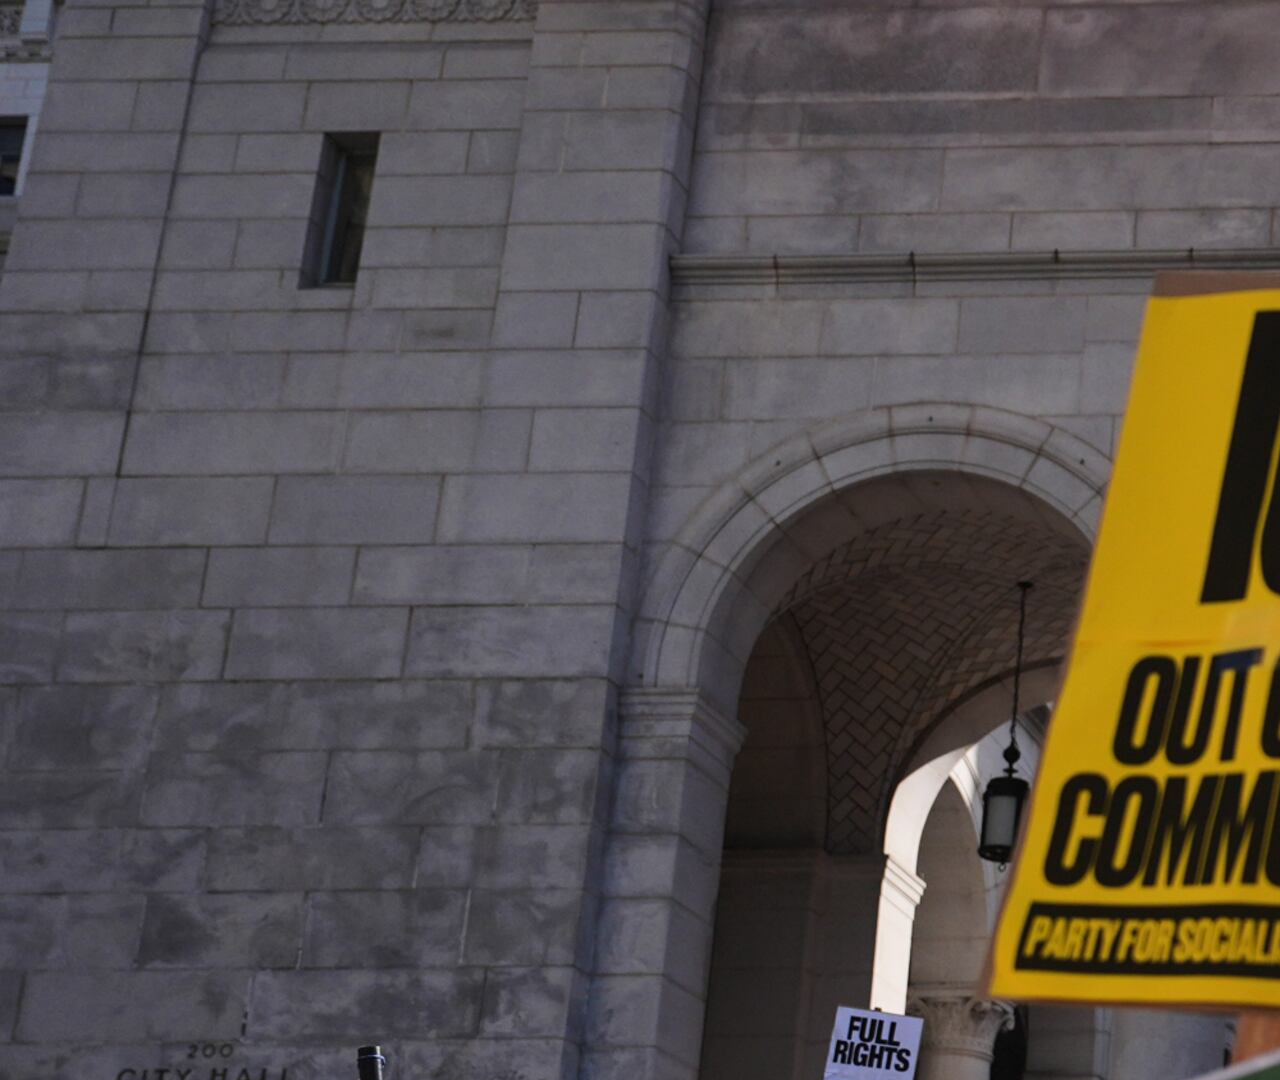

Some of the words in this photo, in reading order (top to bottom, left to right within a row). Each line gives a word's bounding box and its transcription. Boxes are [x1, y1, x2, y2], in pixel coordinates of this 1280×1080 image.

[1112, 648, 1264, 765] OUT
[1027, 916, 1122, 960] PARTY
[1118, 918, 1177, 960] FOR
[847, 1015, 901, 1046] FULL
[187, 1043, 233, 1059] 200
[832, 1039, 911, 1072] RIGHTS
